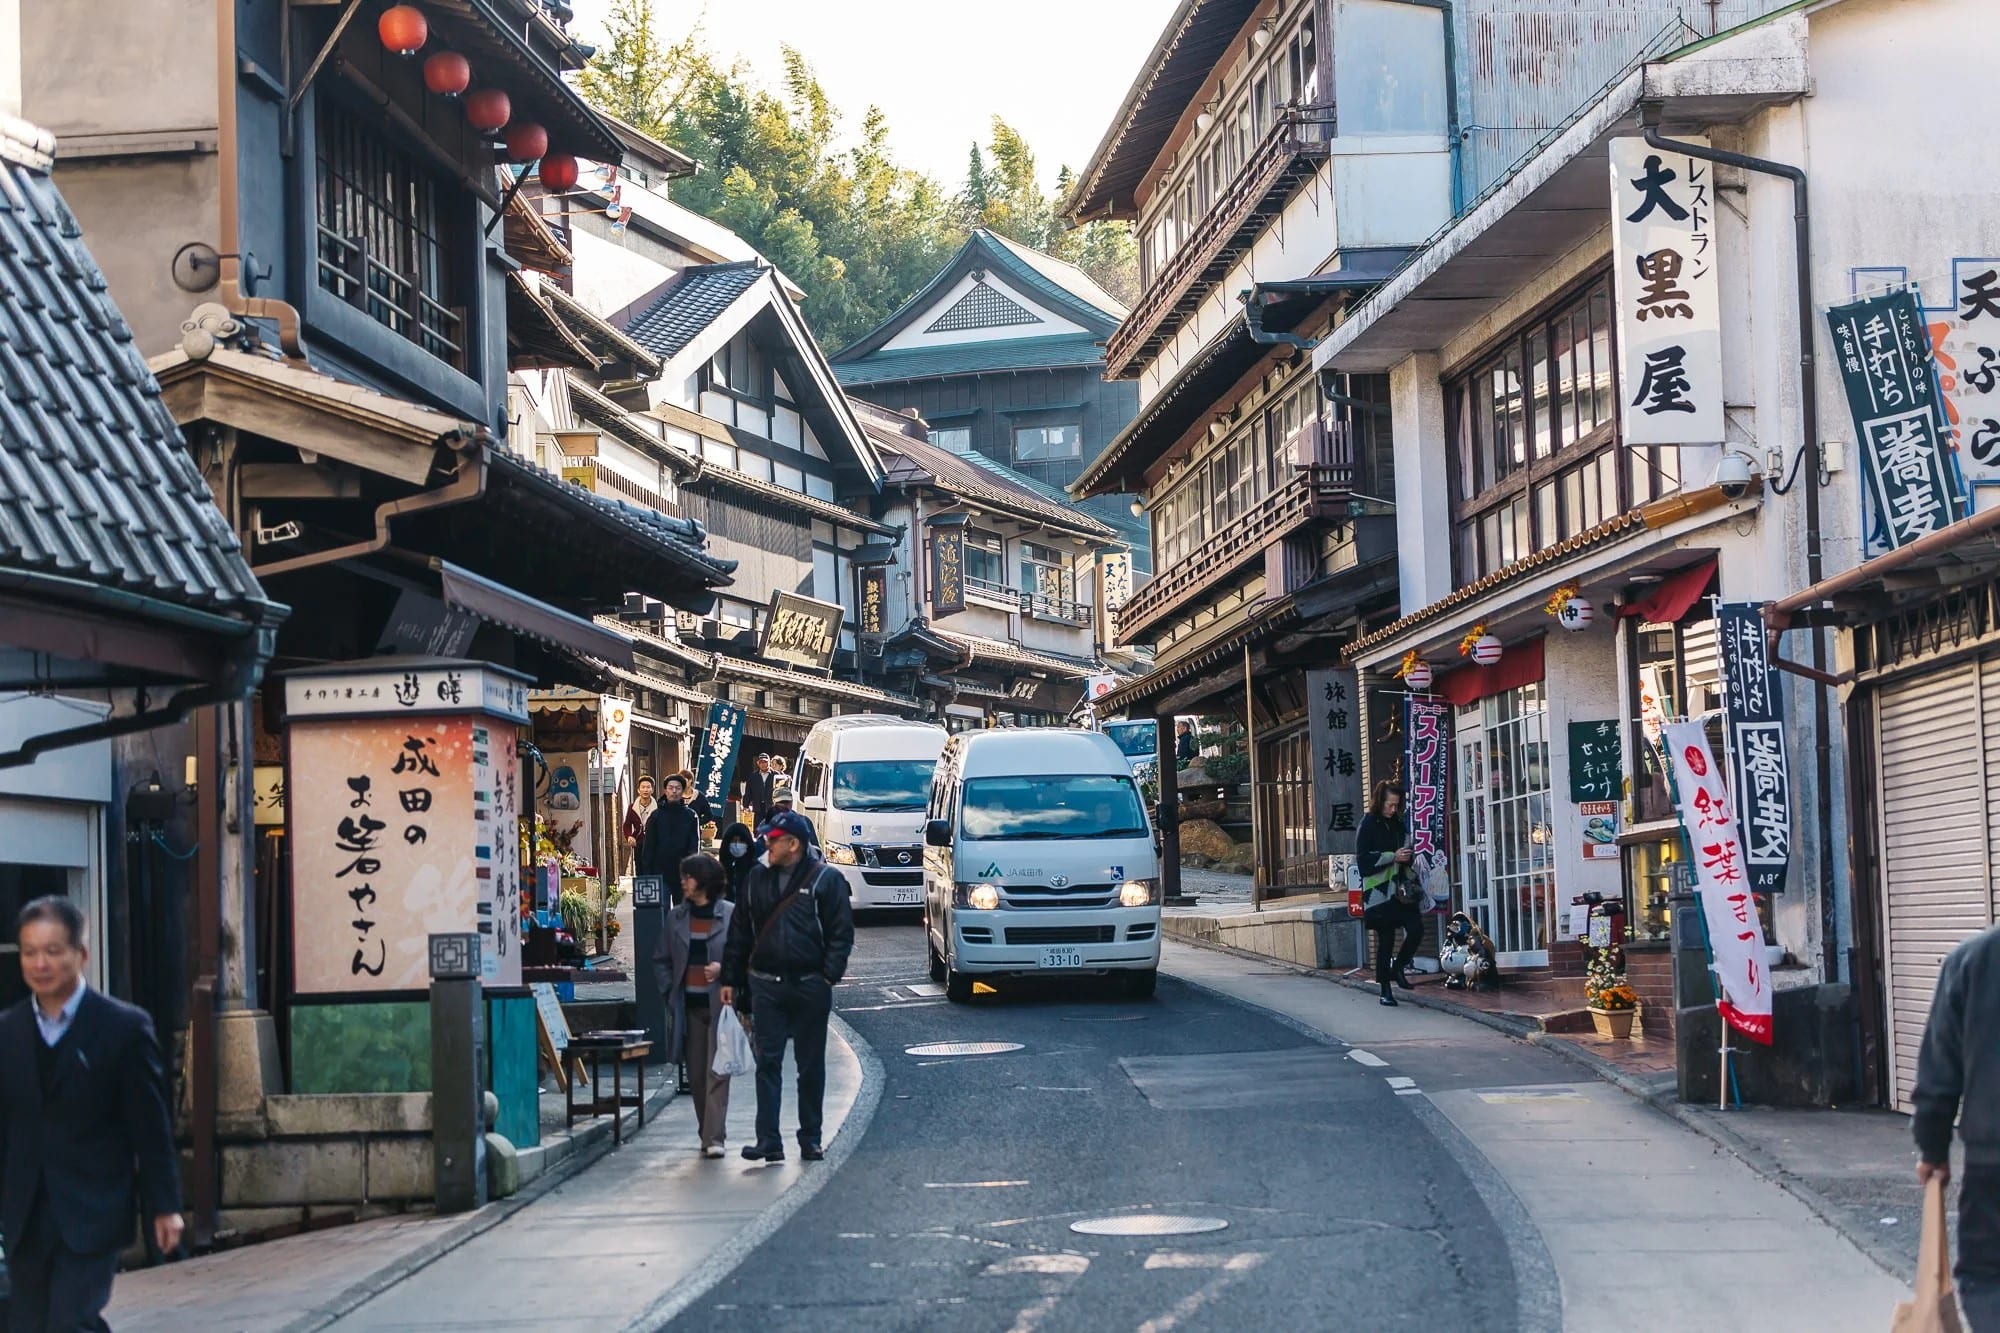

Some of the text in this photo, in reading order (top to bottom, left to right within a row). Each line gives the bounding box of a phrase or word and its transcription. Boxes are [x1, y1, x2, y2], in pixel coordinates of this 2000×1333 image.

[1688, 157, 1709, 280] レストラン
[1626, 154, 1696, 415] 大黒屋
[1836, 323, 1862, 374] 味自慢
[1862, 314, 1904, 407] 手打ち
[1898, 308, 1928, 395] こだわりの味
[1879, 420, 1944, 544] 蕎麦
[1117, 554, 1128, 602] うなぎ
[304, 687, 380, 700] 手作り箸工房
[1413, 703, 1448, 715] チャーミー
[391, 735, 441, 845] 成田の
[1414, 715, 1439, 855] スノーアイス
[1438, 778, 1446, 811] SNOW
[335, 774, 387, 977] お箸やさん
[897, 893, 918, 902] 77-11
[1694, 786, 1761, 997] 紅葉まつり
[1049, 954, 1080, 966] 33-10
